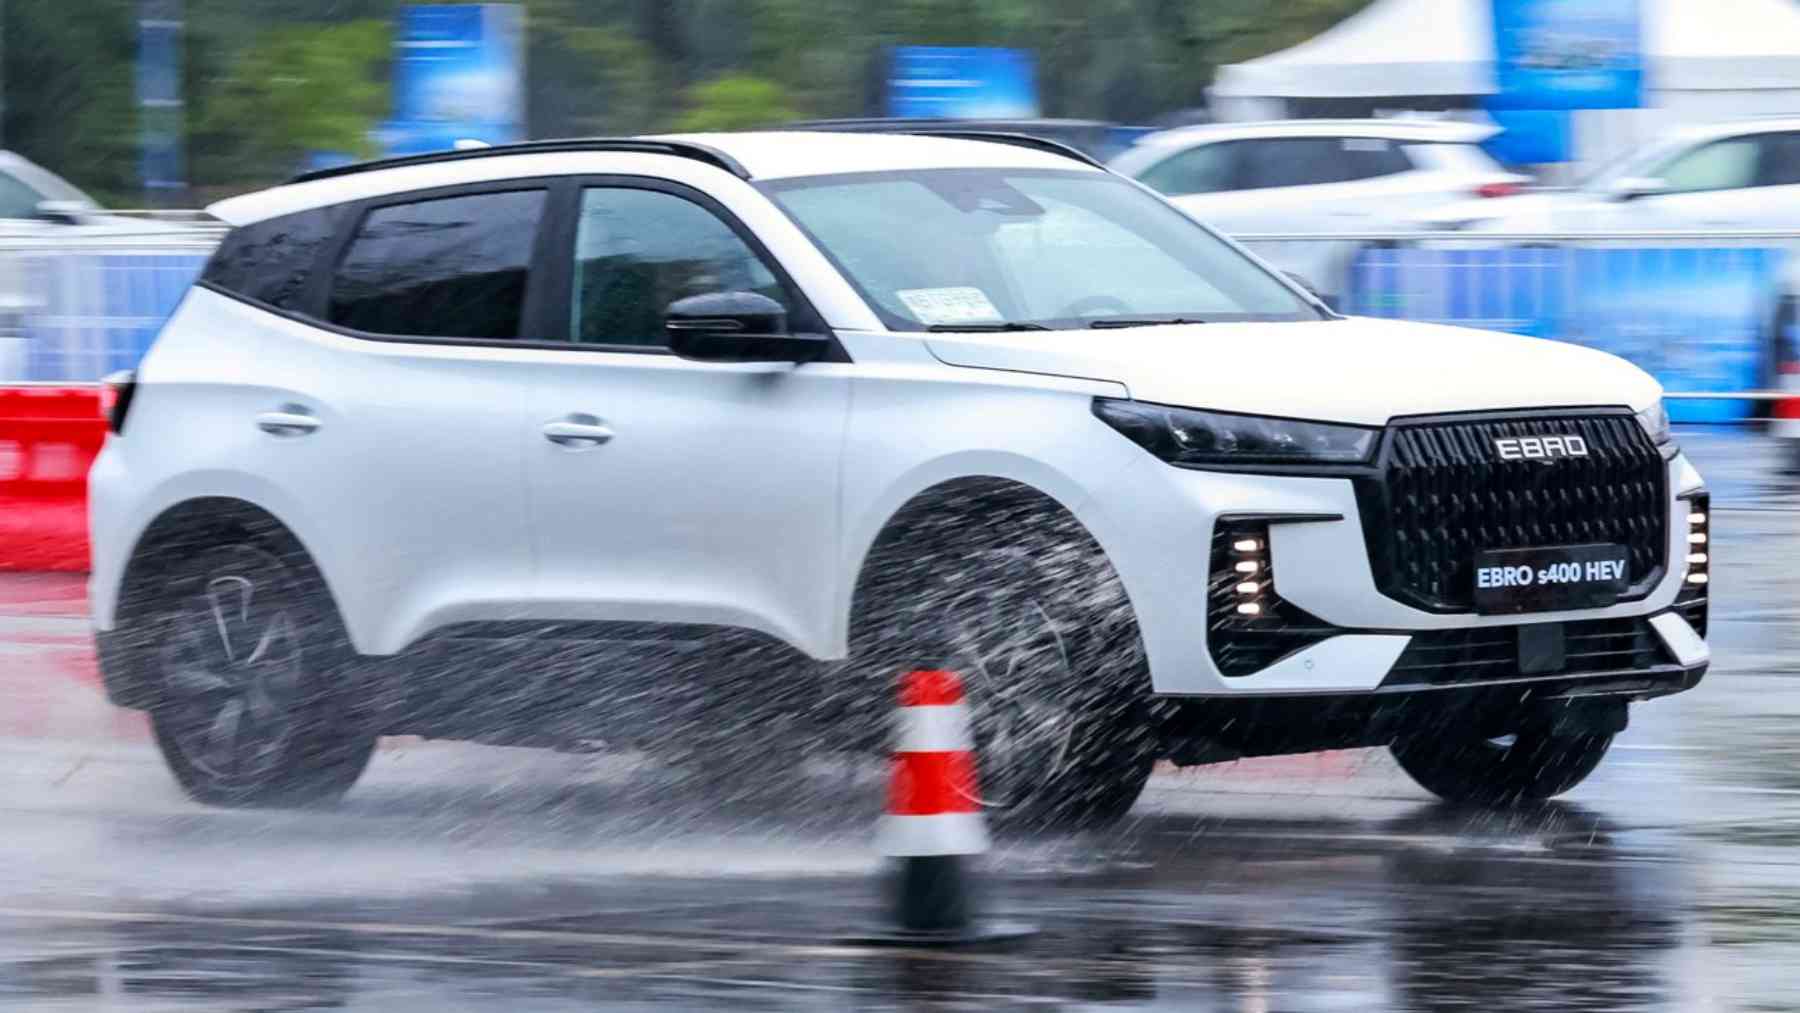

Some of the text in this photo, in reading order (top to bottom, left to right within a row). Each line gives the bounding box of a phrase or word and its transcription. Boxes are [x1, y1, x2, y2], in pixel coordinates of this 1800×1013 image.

[1495, 436, 1588, 459] EBRO
[1477, 560, 1625, 588] EBRO s400 HEV
